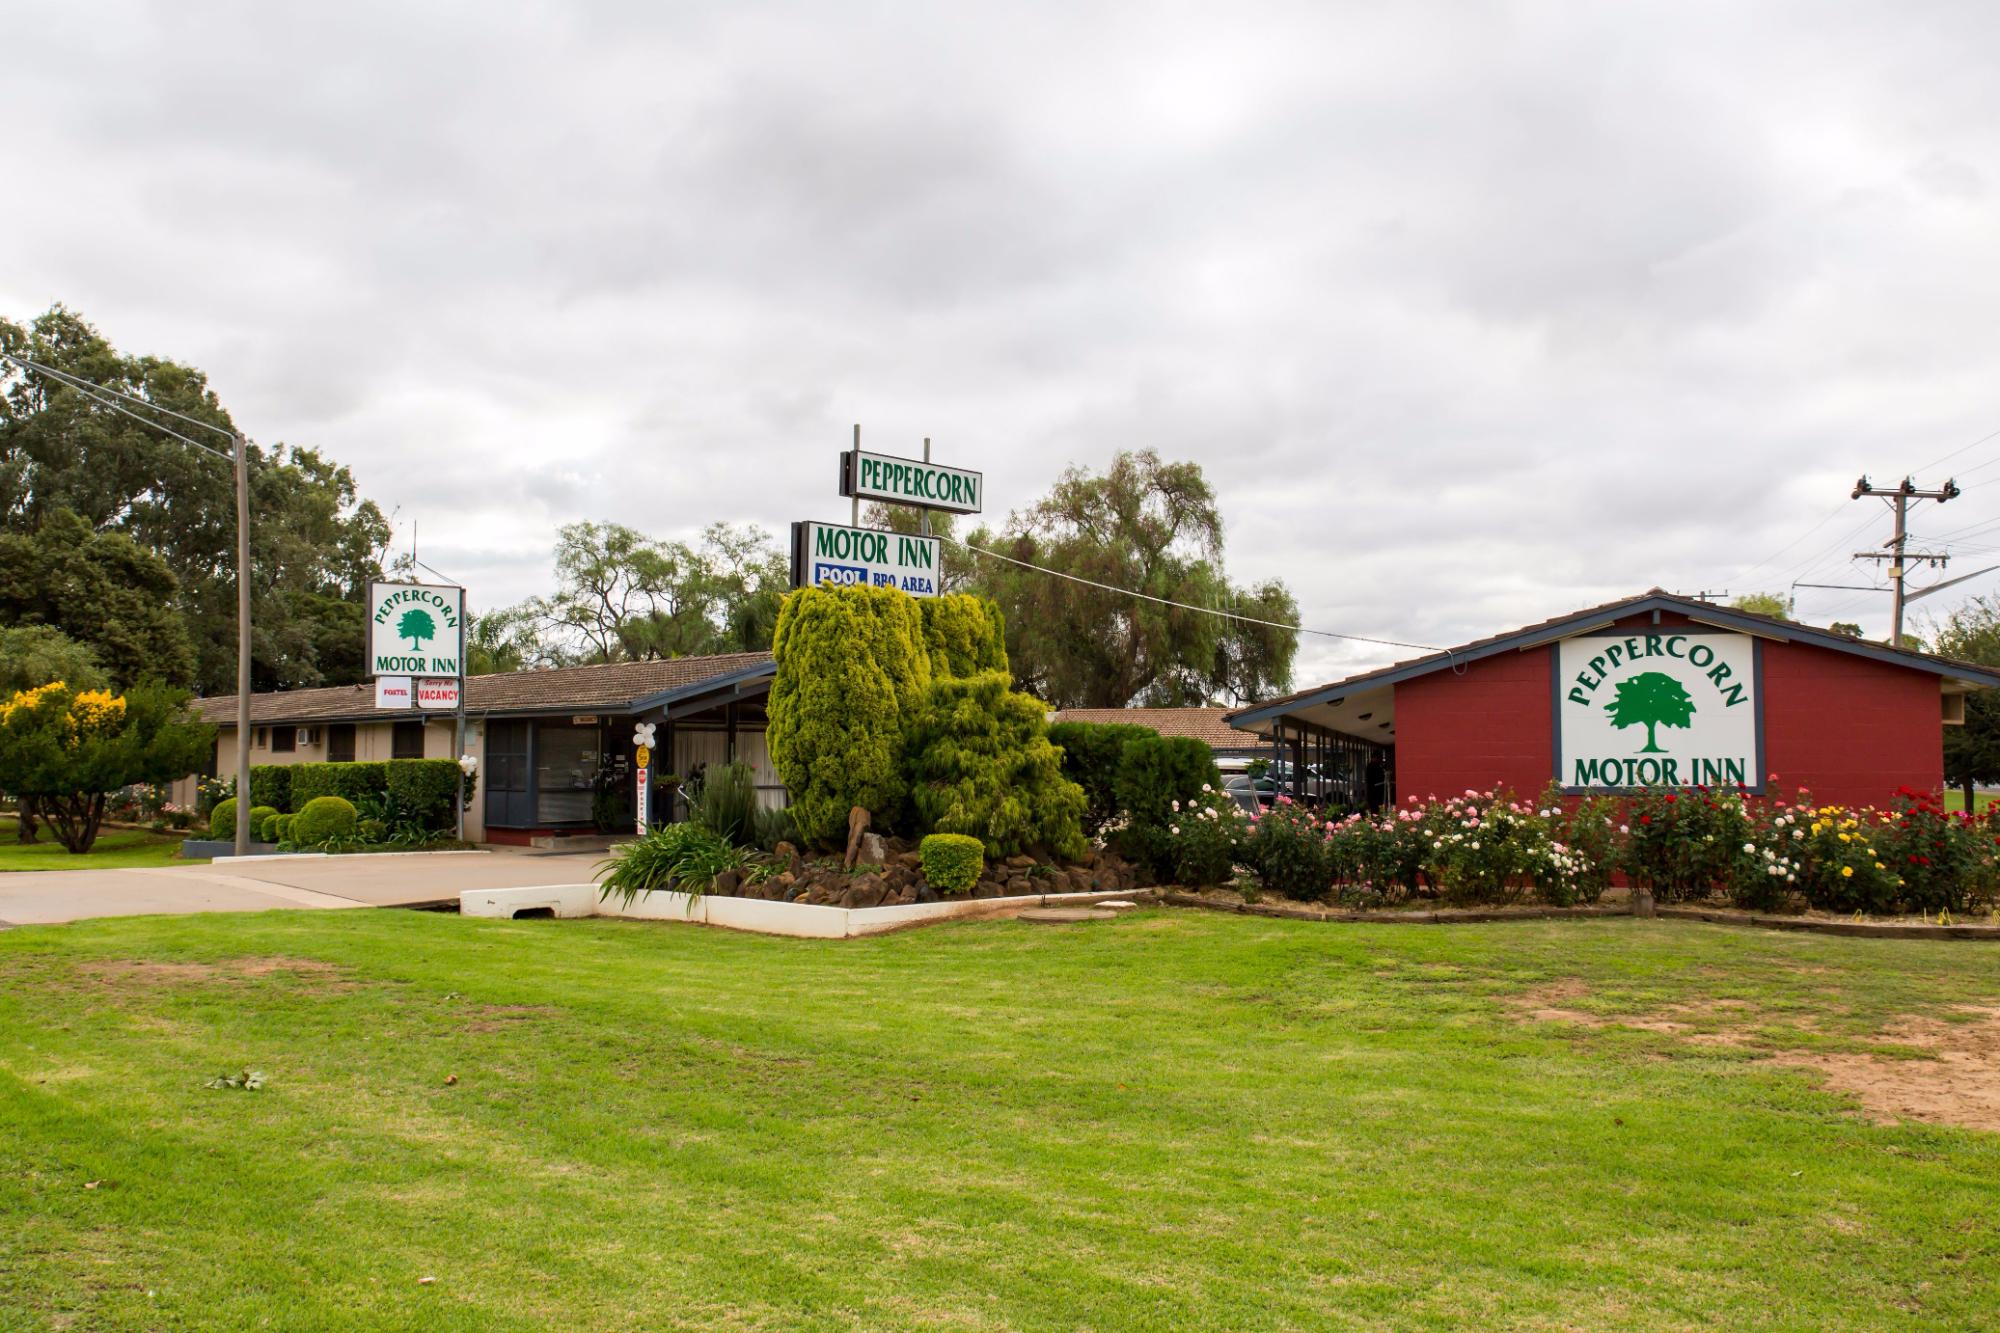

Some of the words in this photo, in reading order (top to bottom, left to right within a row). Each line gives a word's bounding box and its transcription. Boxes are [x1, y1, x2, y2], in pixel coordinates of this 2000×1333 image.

[861, 458, 977, 506] PEPPERCORN
[815, 527, 888, 564] MOTOR
[898, 537, 933, 570] INN
[901, 576, 933, 594] AREA
[374, 589, 458, 628] PEPPERCORN
[376, 656, 426, 672] MOTOR
[432, 658, 457, 673] INN
[1568, 635, 1749, 708] PEPPERCORN
[418, 690, 459, 701] VACANCY
[1574, 758, 1682, 787] MOTOR
[1691, 758, 1745, 786] INN
